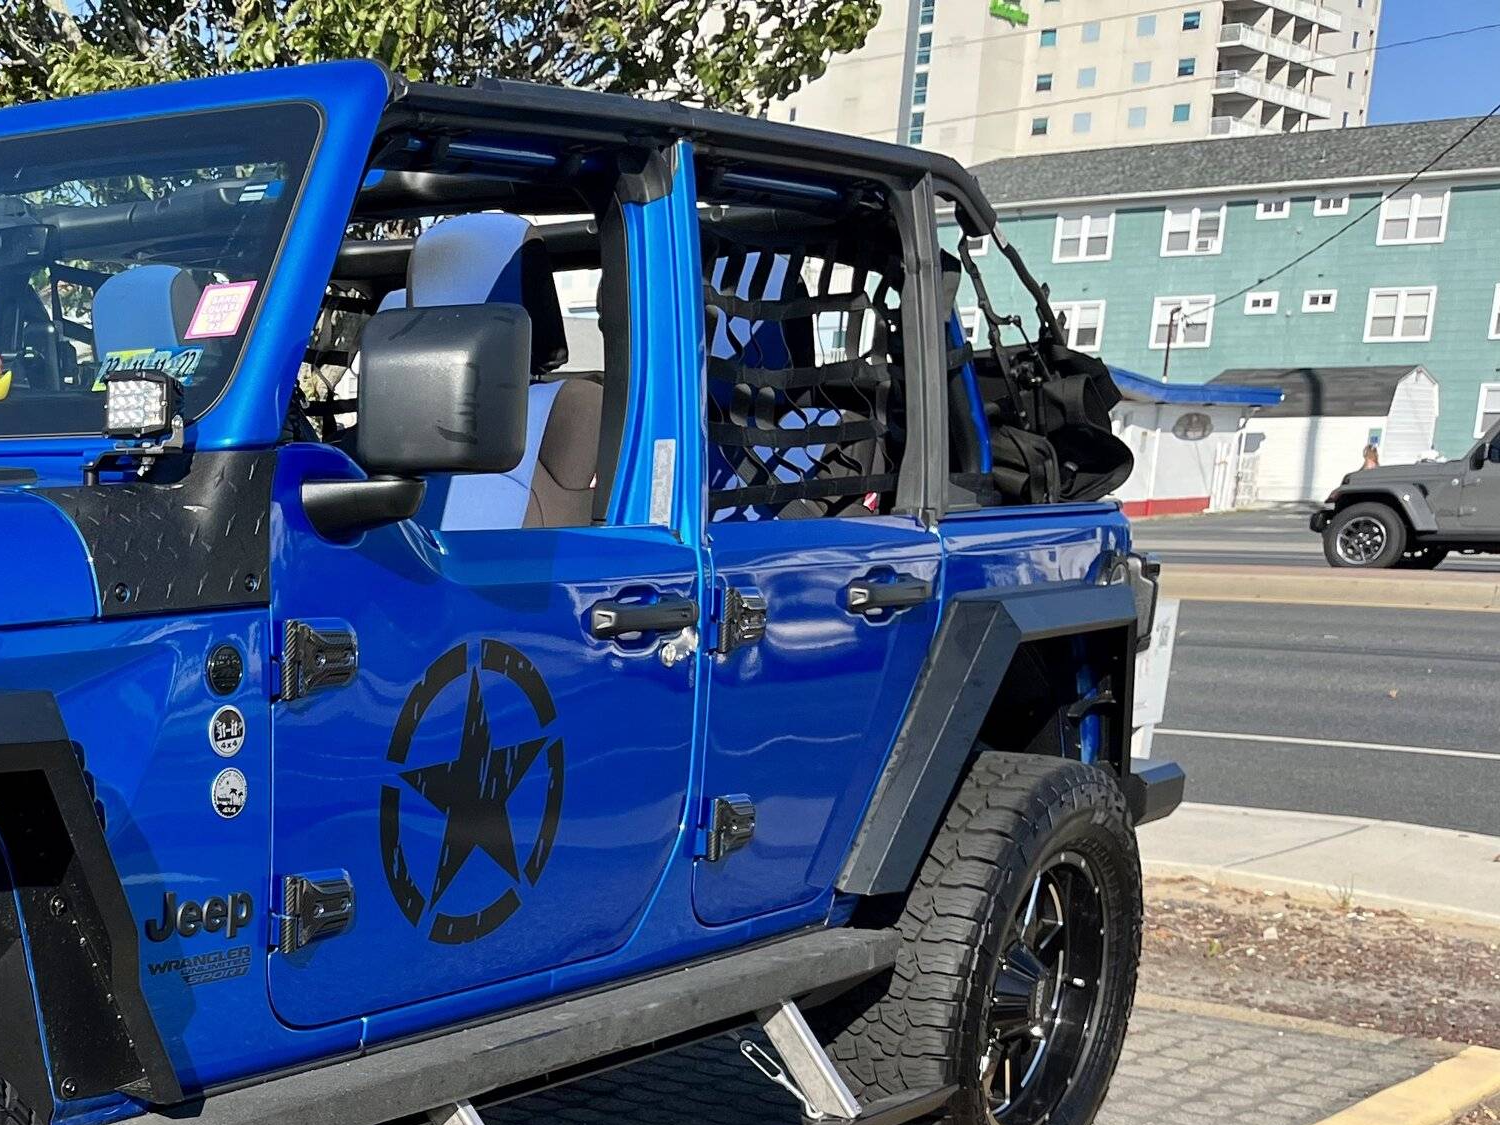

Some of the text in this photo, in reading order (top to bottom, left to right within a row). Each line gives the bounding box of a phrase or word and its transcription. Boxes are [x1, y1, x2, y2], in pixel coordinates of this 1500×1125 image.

[145, 890, 254, 942] Jeep
[148, 946, 251, 975] WRANGLER
[180, 958, 251, 975] UNLIMITED
[188, 966, 247, 984] SPORT
